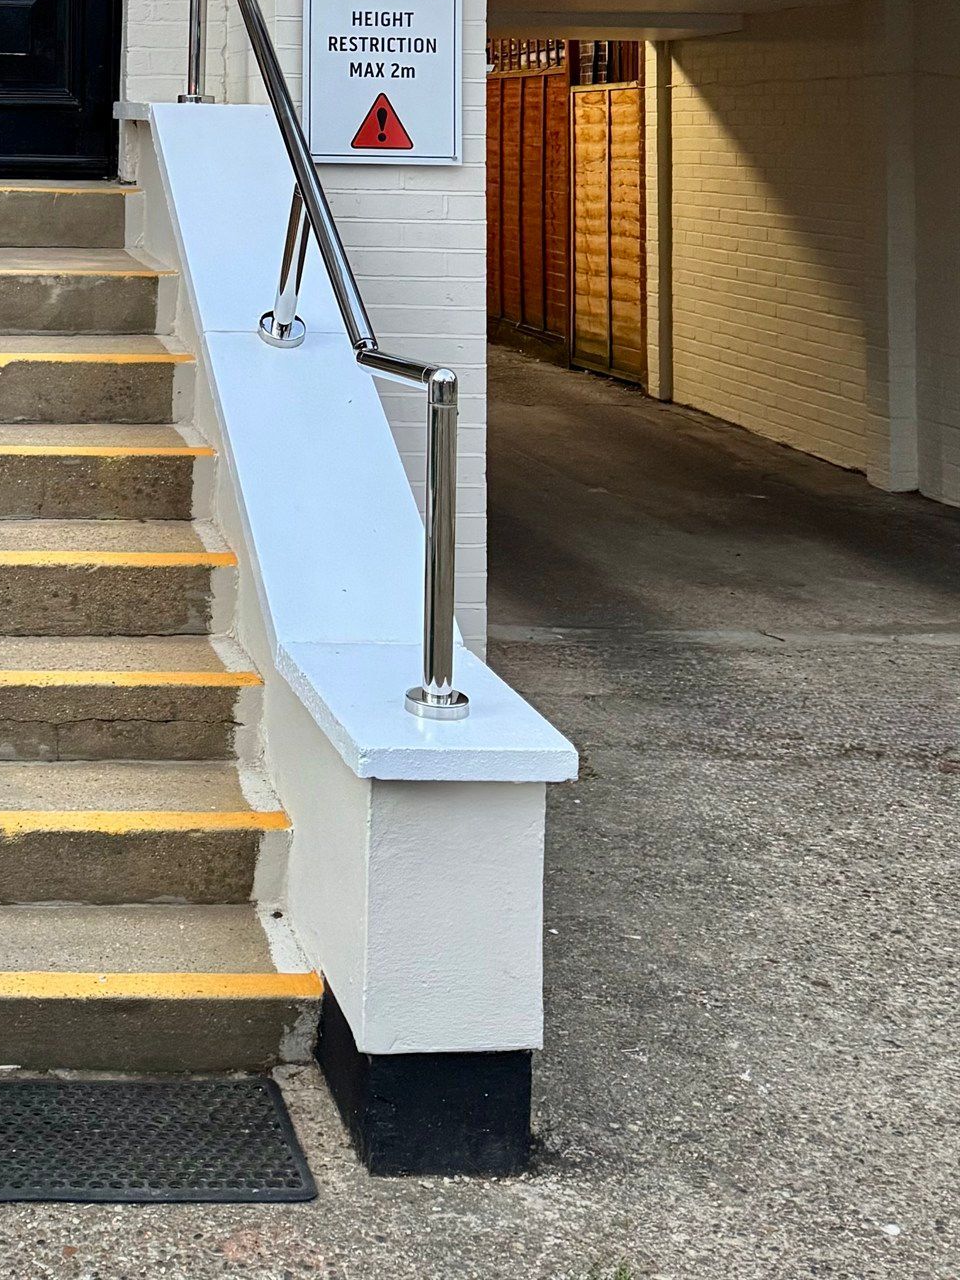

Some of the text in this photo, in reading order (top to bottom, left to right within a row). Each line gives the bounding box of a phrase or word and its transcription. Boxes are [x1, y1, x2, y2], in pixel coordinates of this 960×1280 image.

[351, 10, 415, 28] HEIGHT
[327, 36, 438, 54] RESTRICTION
[349, 62, 416, 79] MAX 2m
